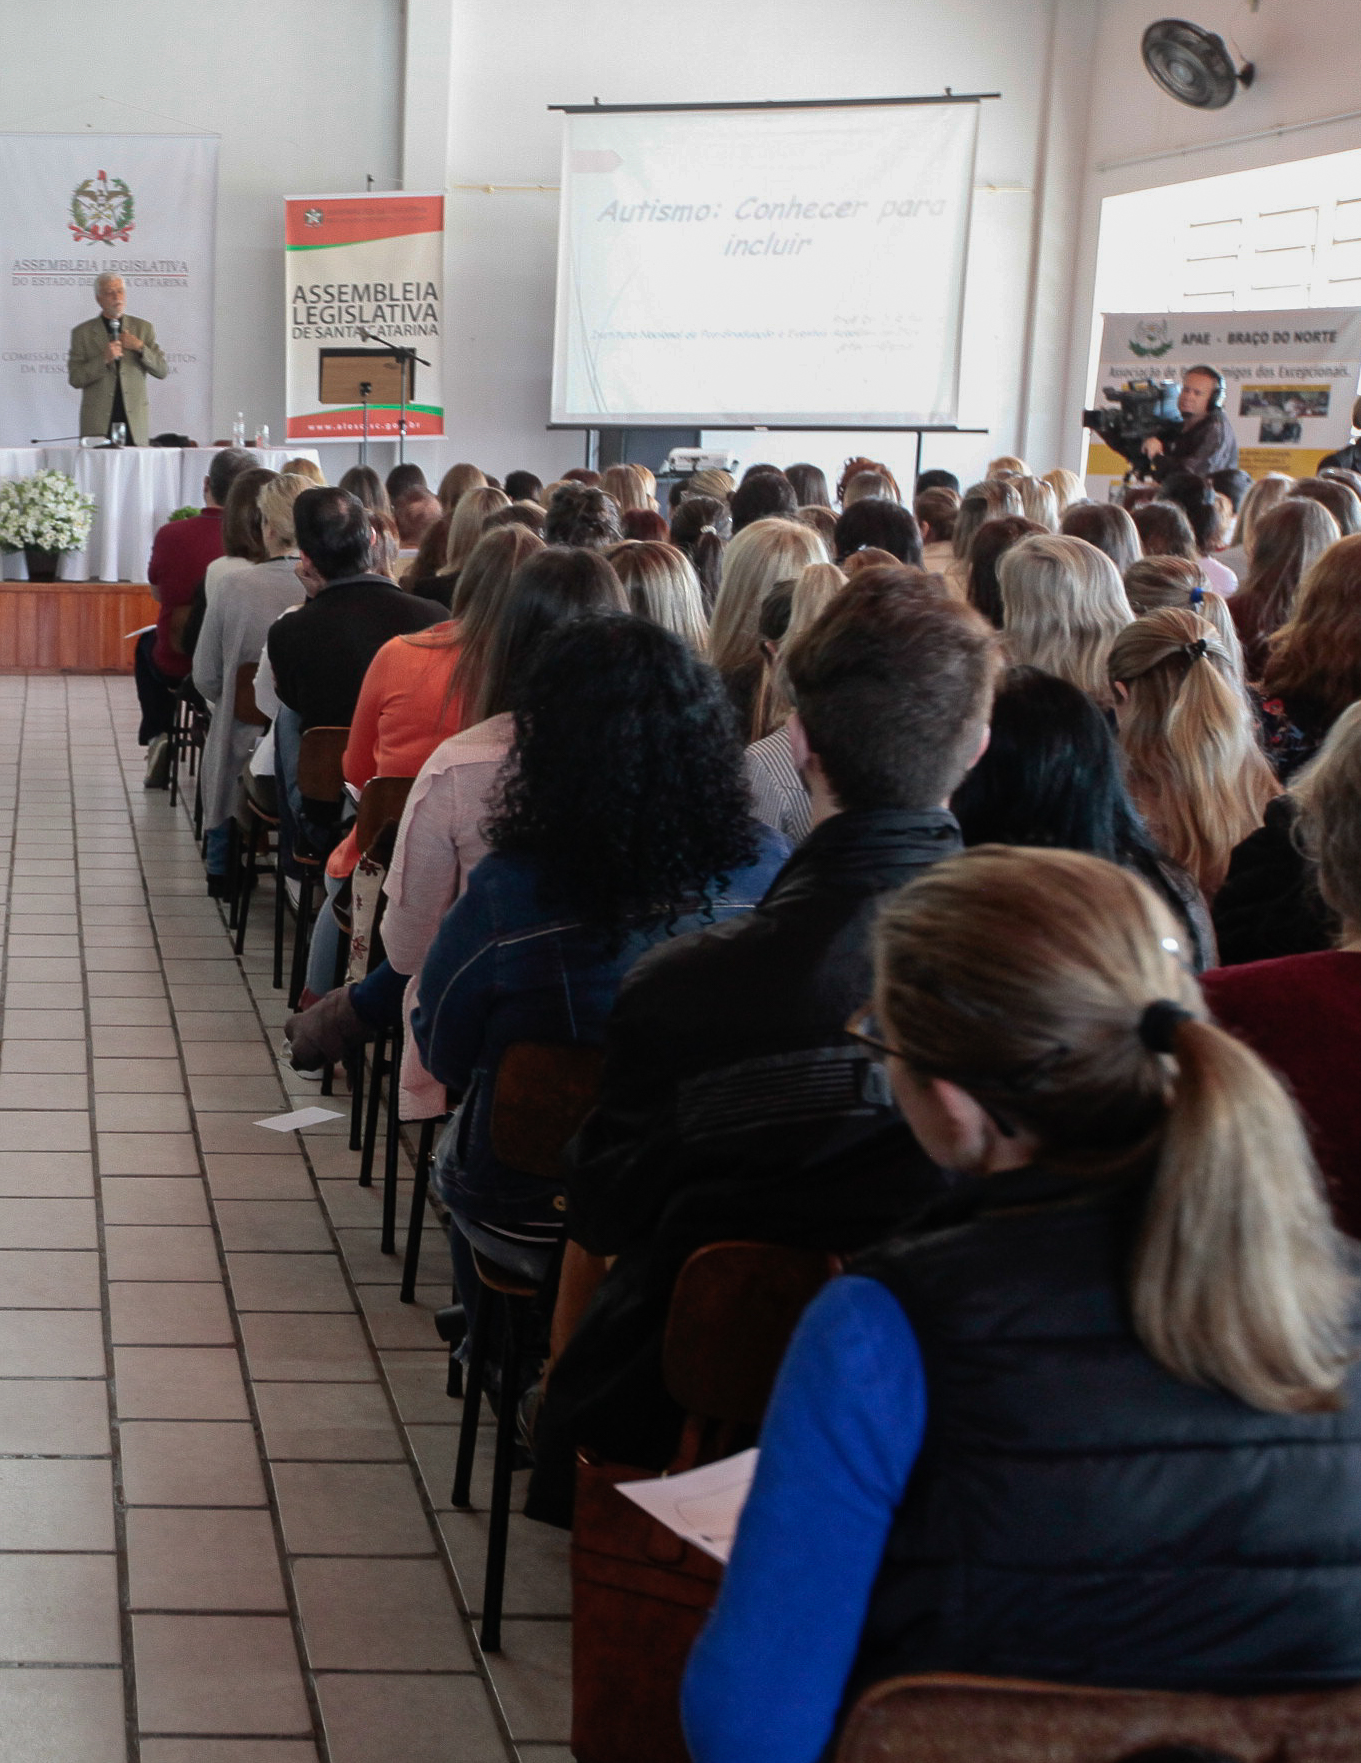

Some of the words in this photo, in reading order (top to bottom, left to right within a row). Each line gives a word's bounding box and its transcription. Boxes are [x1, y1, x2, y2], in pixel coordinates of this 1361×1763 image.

[596, 198, 722, 223] Autismo:
[735, 195, 868, 221] Conhecer
[878, 198, 945, 224] para
[724, 232, 812, 256] incluir
[13, 259, 98, 272] ASSEMBLEIA
[102, 259, 188, 273] LEGISLATIVA
[12, 276, 28, 286] DO
[32, 276, 76, 287] ESTADO
[134, 277, 188, 288] CATARINA
[292, 281, 439, 304] ASSEMBLEIA
[293, 302, 439, 326] LEGISLATIVA
[292, 327, 312, 339] DE
[1181, 332, 1210, 345] APAE
[1227, 331, 1269, 347] BRAÇO
[1273, 330, 1290, 344] DO
[1294, 329, 1337, 343] NORTE
